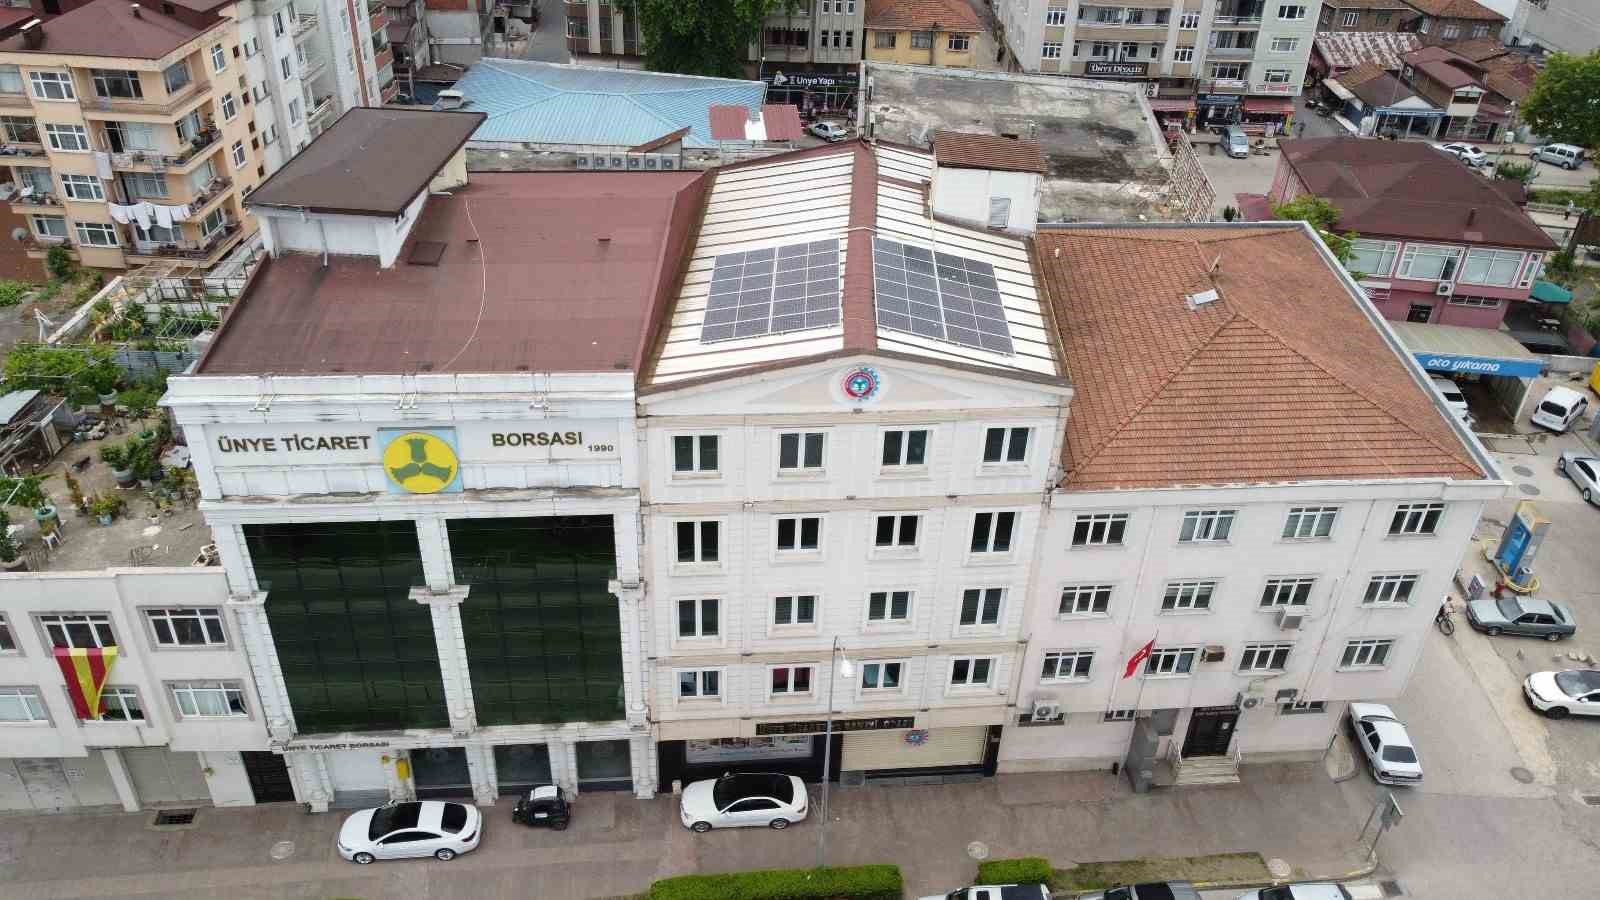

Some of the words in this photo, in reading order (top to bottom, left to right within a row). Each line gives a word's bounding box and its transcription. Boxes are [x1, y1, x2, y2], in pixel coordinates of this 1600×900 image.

[217, 435, 277, 453] ÜNYE
[281, 433, 371, 451] TİCARET
[491, 431, 583, 447] BORSASI
[588, 444, 614, 452] 1990
